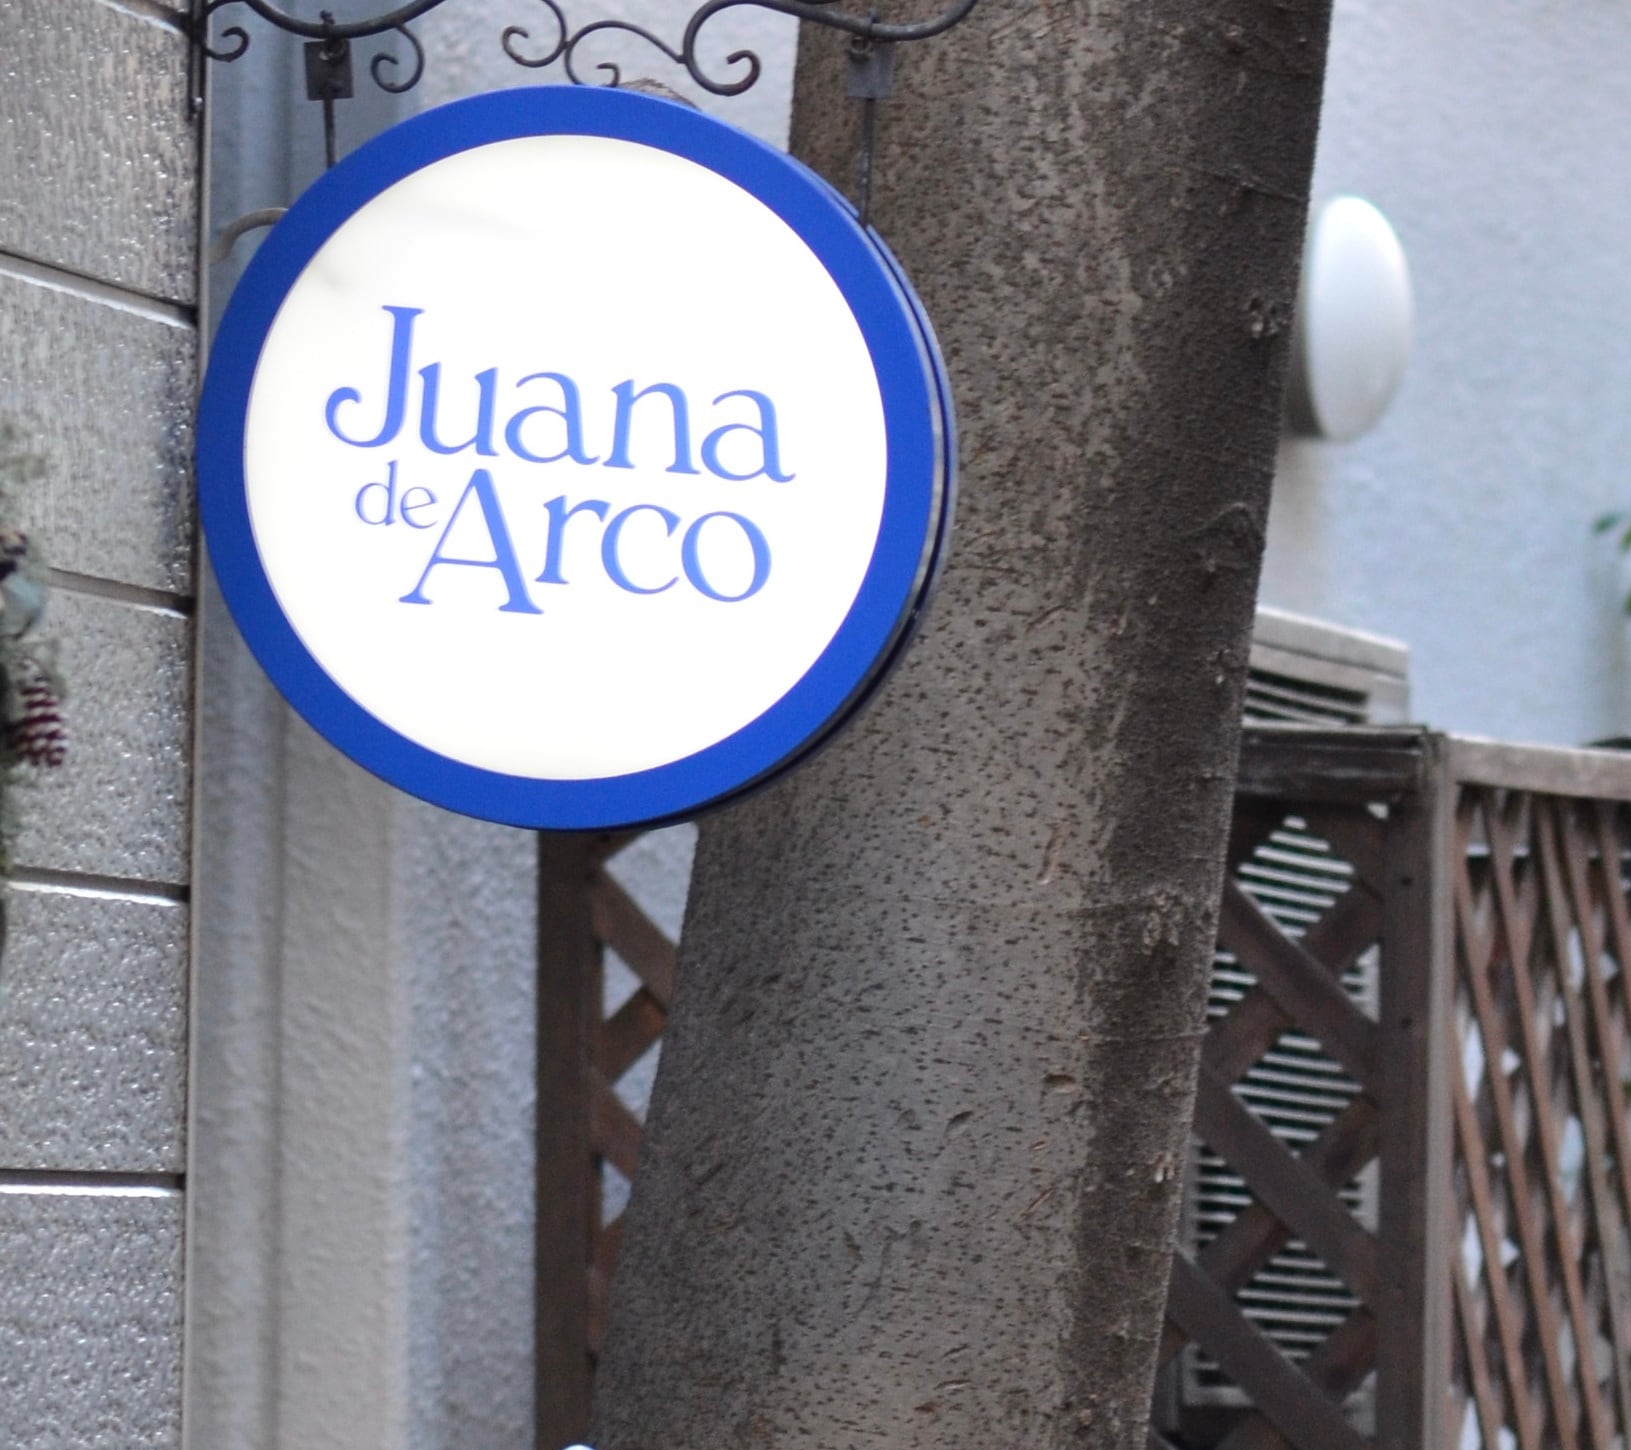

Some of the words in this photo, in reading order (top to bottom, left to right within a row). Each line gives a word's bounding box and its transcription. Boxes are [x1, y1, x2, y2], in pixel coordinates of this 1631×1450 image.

[325, 305, 797, 483] Juana
[355, 460, 438, 528] de
[399, 468, 771, 615] Arco
